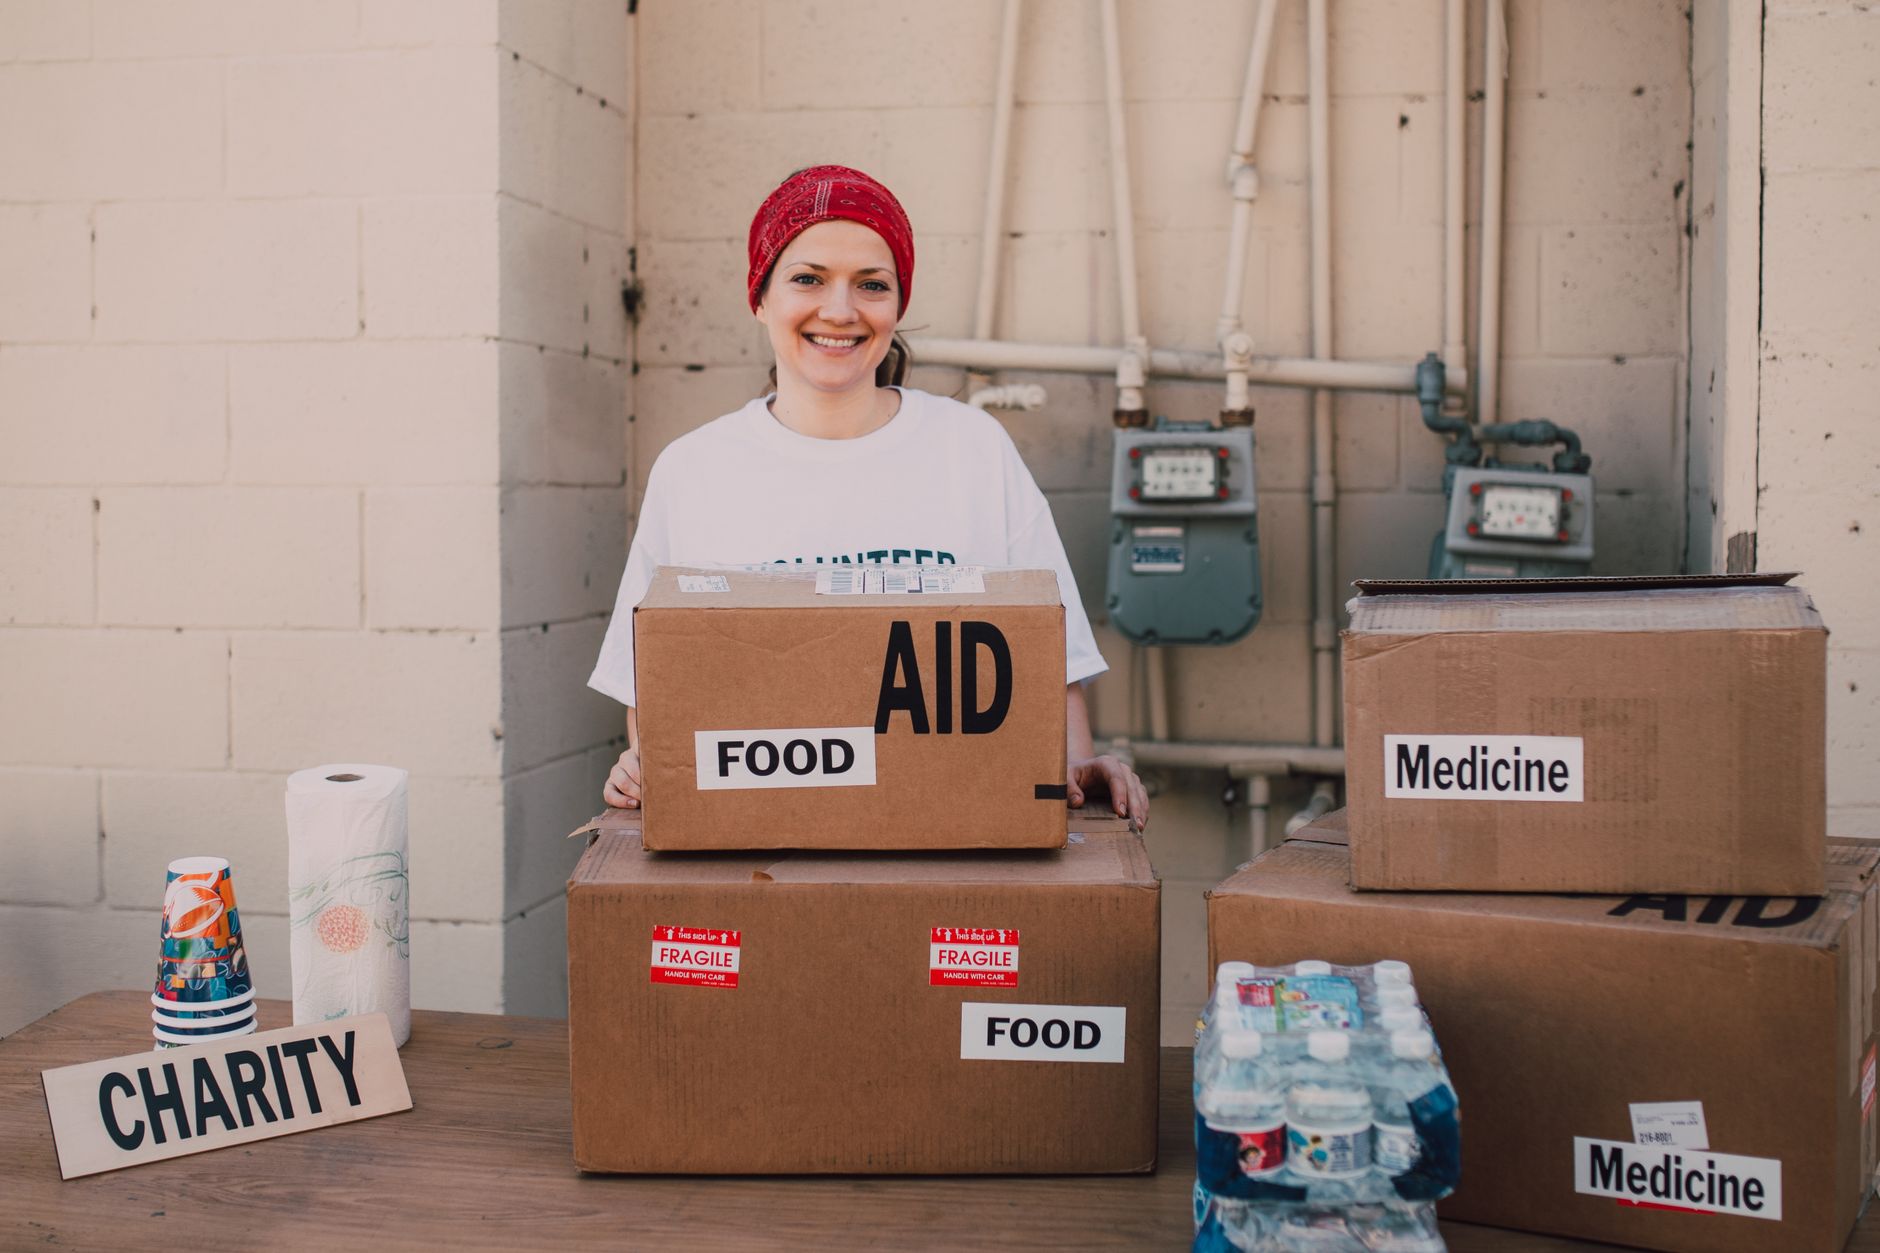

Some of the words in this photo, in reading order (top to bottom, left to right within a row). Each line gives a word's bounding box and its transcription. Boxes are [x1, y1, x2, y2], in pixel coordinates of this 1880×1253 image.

[875, 621, 1013, 735] AID
[718, 739, 855, 777] FOOD
[1397, 743, 1569, 793] Medicine
[678, 932, 692, 940] THIS
[692, 933, 707, 941] SIDE
[707, 934, 717, 942] UP
[970, 933, 985, 941] SIDE
[660, 947, 733, 968] FRAGILE
[938, 949, 1012, 967] FRAGILE
[664, 970, 690, 979] HANDLE
[691, 972, 707, 980] WITH
[707, 973, 726, 982] CARE
[943, 971, 969, 979] HANDLE
[970, 972, 986, 980] WITH
[986, 973, 1005, 981] CARE
[986, 1016, 1102, 1050] FOOD
[98, 1030, 362, 1151] CHARITY
[1590, 1144, 1764, 1212] Medicine
